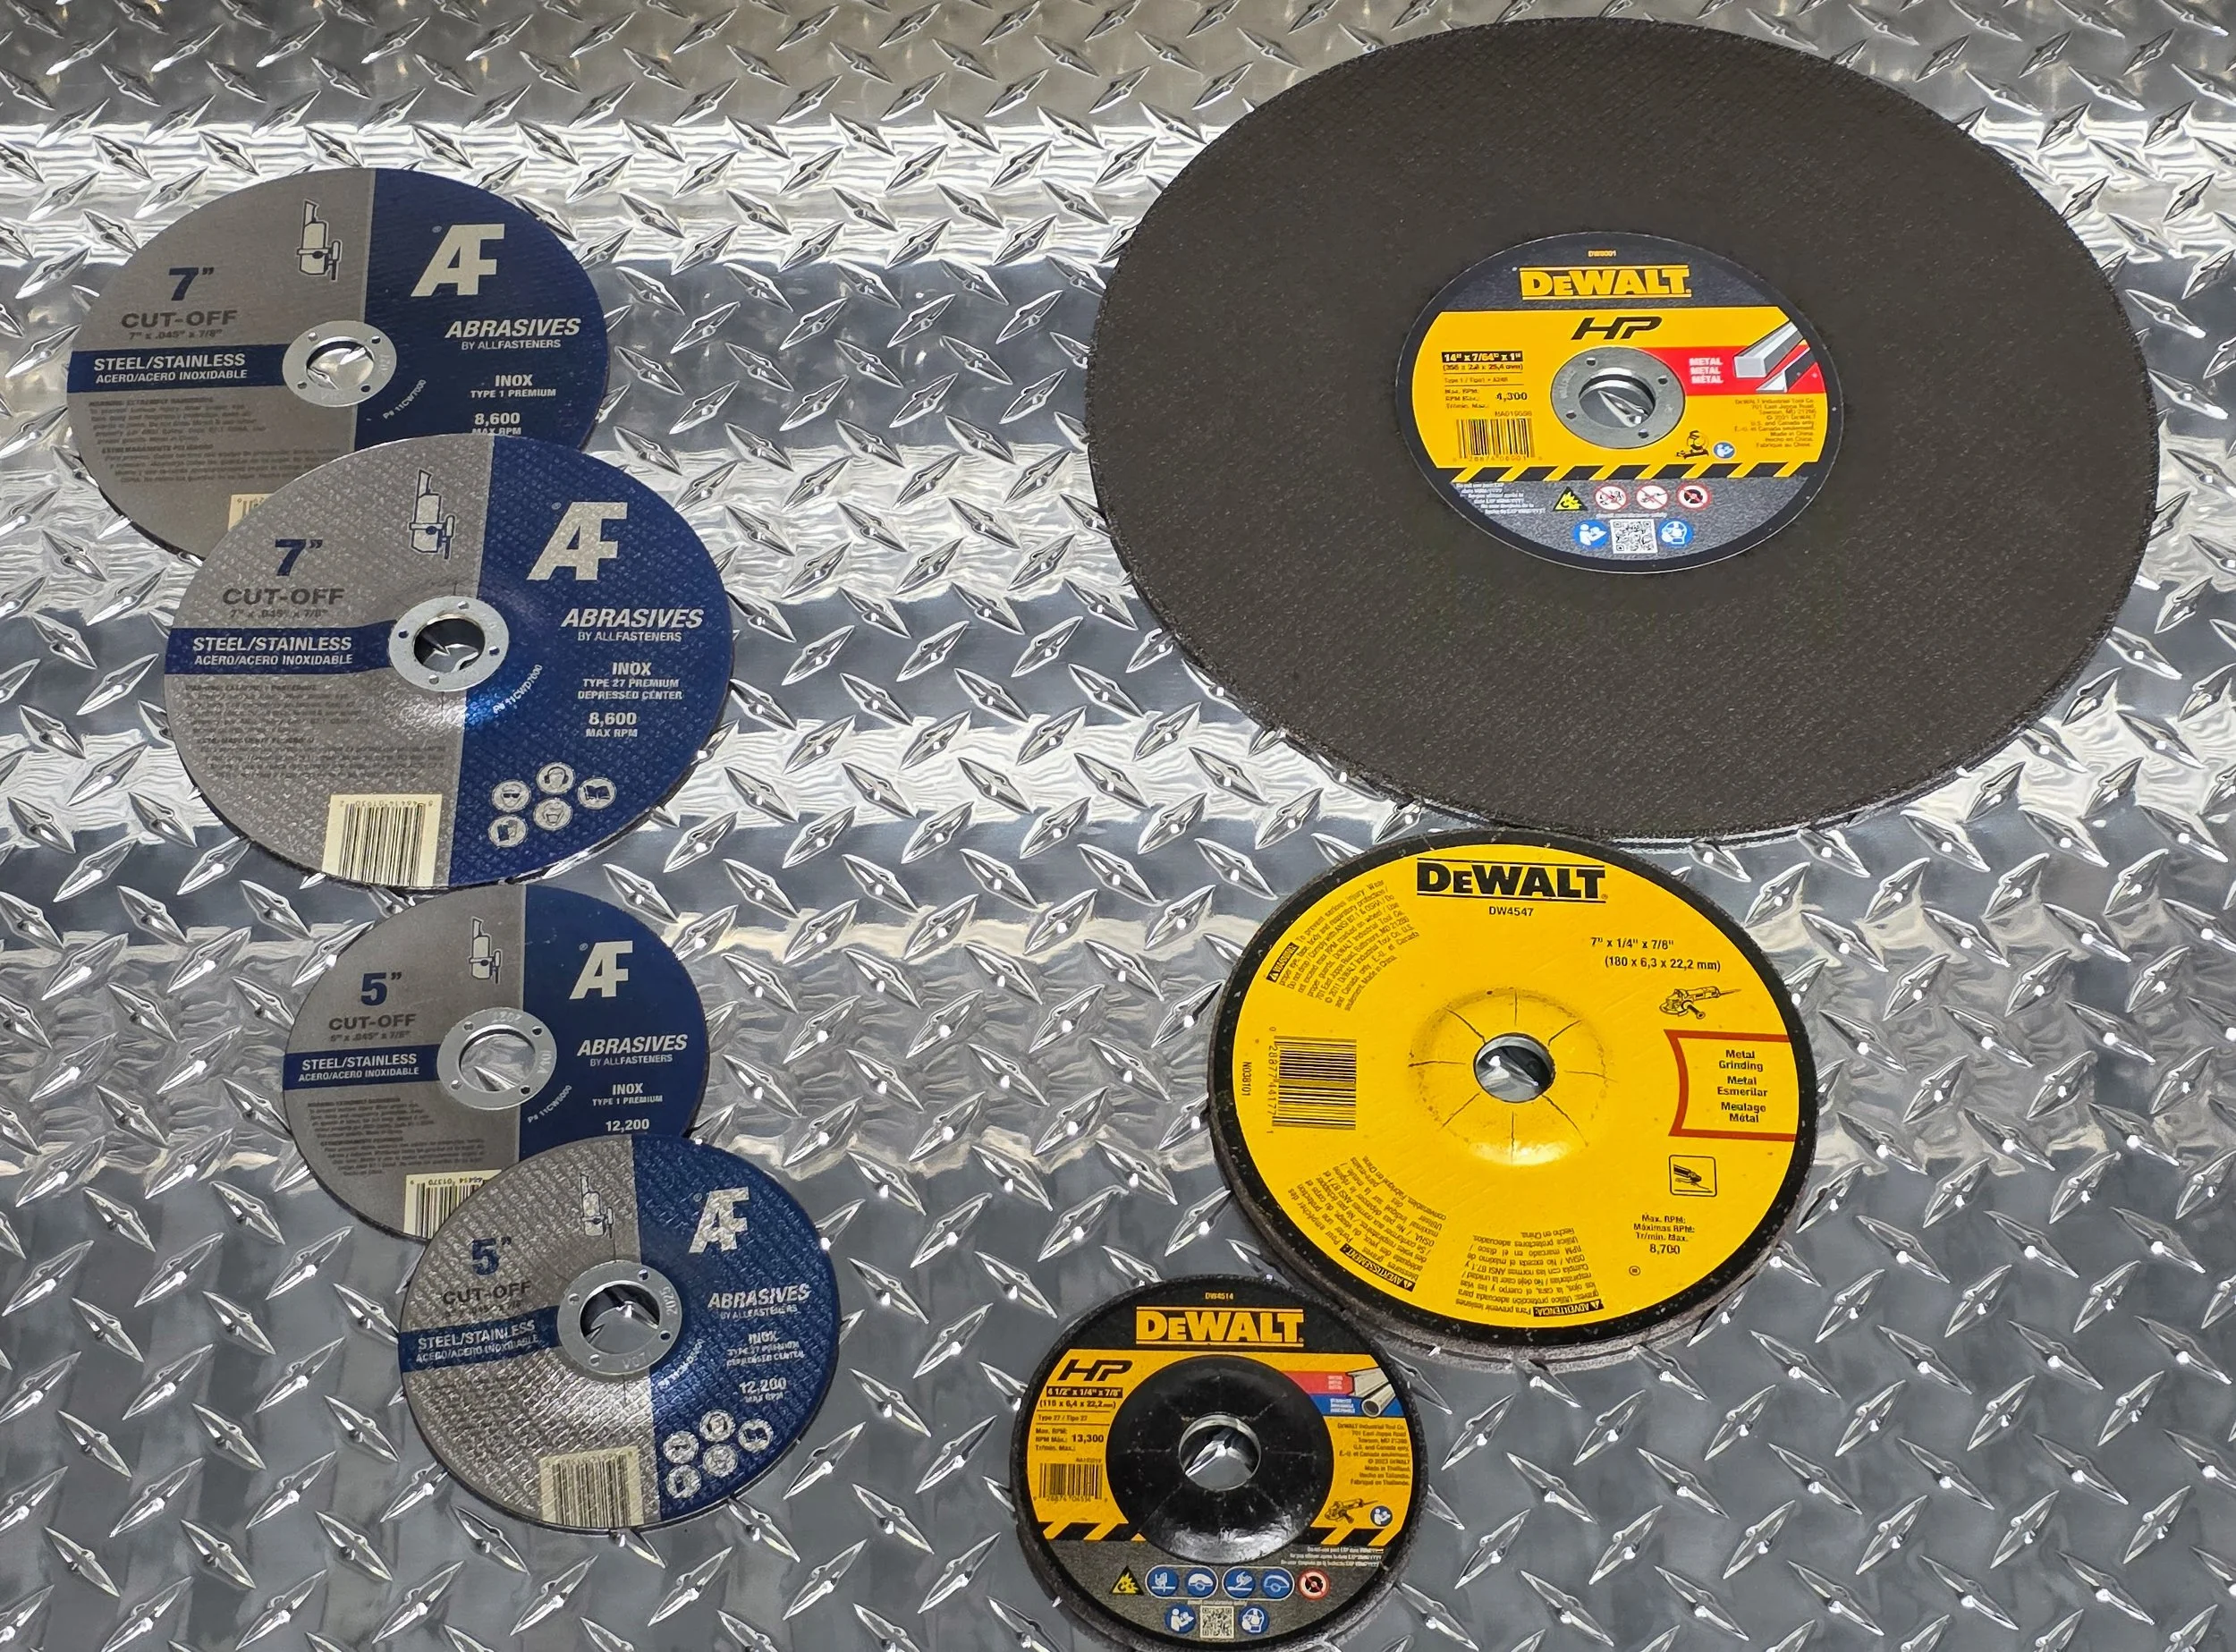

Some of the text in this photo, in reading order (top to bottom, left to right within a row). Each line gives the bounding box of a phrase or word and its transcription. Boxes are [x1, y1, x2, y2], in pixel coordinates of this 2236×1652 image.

[411, 224, 505, 297] AF
[121, 309, 238, 328] CUT-OFF
[444, 318, 581, 338] ABRASIVES
[1571, 315, 1663, 341] HP
[461, 339, 562, 350] BY ALLFASTENERS
[94, 353, 246, 371] STEEL/STAINLESS
[1689, 357, 1724, 366] METAL
[95, 369, 248, 384] ACERO/ACERO INOXIDABLE
[1690, 367, 1721, 375] METAL
[495, 374, 534, 386] INOX
[470, 390, 496, 398] TYPE
[507, 388, 556, 397] PREMIUM
[1495, 392, 1528, 402] 4,300
[474, 412, 521, 427] 8,600
[497, 427, 521, 436] RPM
[526, 502, 628, 580] AF
[223, 588, 345, 606] CUT-OFF
[560, 608, 705, 629] ABRASIVES
[577, 631, 682, 642] BY ALLFASTENERS
[192, 636, 352, 652] STEEL/STAINLESS
[194, 654, 353, 665] ACERO/ACERO INOXIDABLE
[612, 662, 652, 676] INOX
[583, 678, 680, 688] TYPE 27 PREMIUM
[578, 690, 683, 700] DEPRESSED CENTER
[589, 712, 638, 727] 8,600
[586, 728, 639, 738] MAX RPM
[1488, 905, 1535, 917] DW4547
[1606, 940, 1613, 948] x
[569, 940, 633, 1000] AF
[1605, 956, 1721, 972] (180 x 6,3 x 22,2 mm)
[328, 1013, 417, 1031] CUT-OFF
[577, 1034, 688, 1056] ABRASIVES
[589, 1054, 673, 1067] BY ALLFASTENERS
[1725, 1049, 1756, 1059] Metal
[301, 1054, 417, 1071] STEEL/STAINLESS
[1718, 1060, 1764, 1072] Grinding
[298, 1067, 419, 1082] ACERO/ACERO INOXIDABLE
[1727, 1075, 1757, 1086] Metal
[612, 1082, 644, 1096] INOX
[1717, 1086, 1768, 1097] Esmerilar
[592, 1097, 614, 1106] TYPE
[623, 1095, 663, 1105] PREMIUM
[1721, 1101, 1766, 1114] Meulage
[606, 1118, 650, 1134] 12,200
[688, 1186, 750, 1253] AF
[1641, 1214, 1663, 1223] Max.
[1649, 1243, 1681, 1256] 8,700
[443, 1280, 532, 1305] CUT-OFF
[707, 1283, 812, 1309] ABRASIVES
[418, 1319, 536, 1351] STEEL/STAINLESS
[1057, 1359, 1133, 1382] HP
[739, 1377, 787, 1395] 12,200
[1072, 1434, 1105, 1444] 13,300
